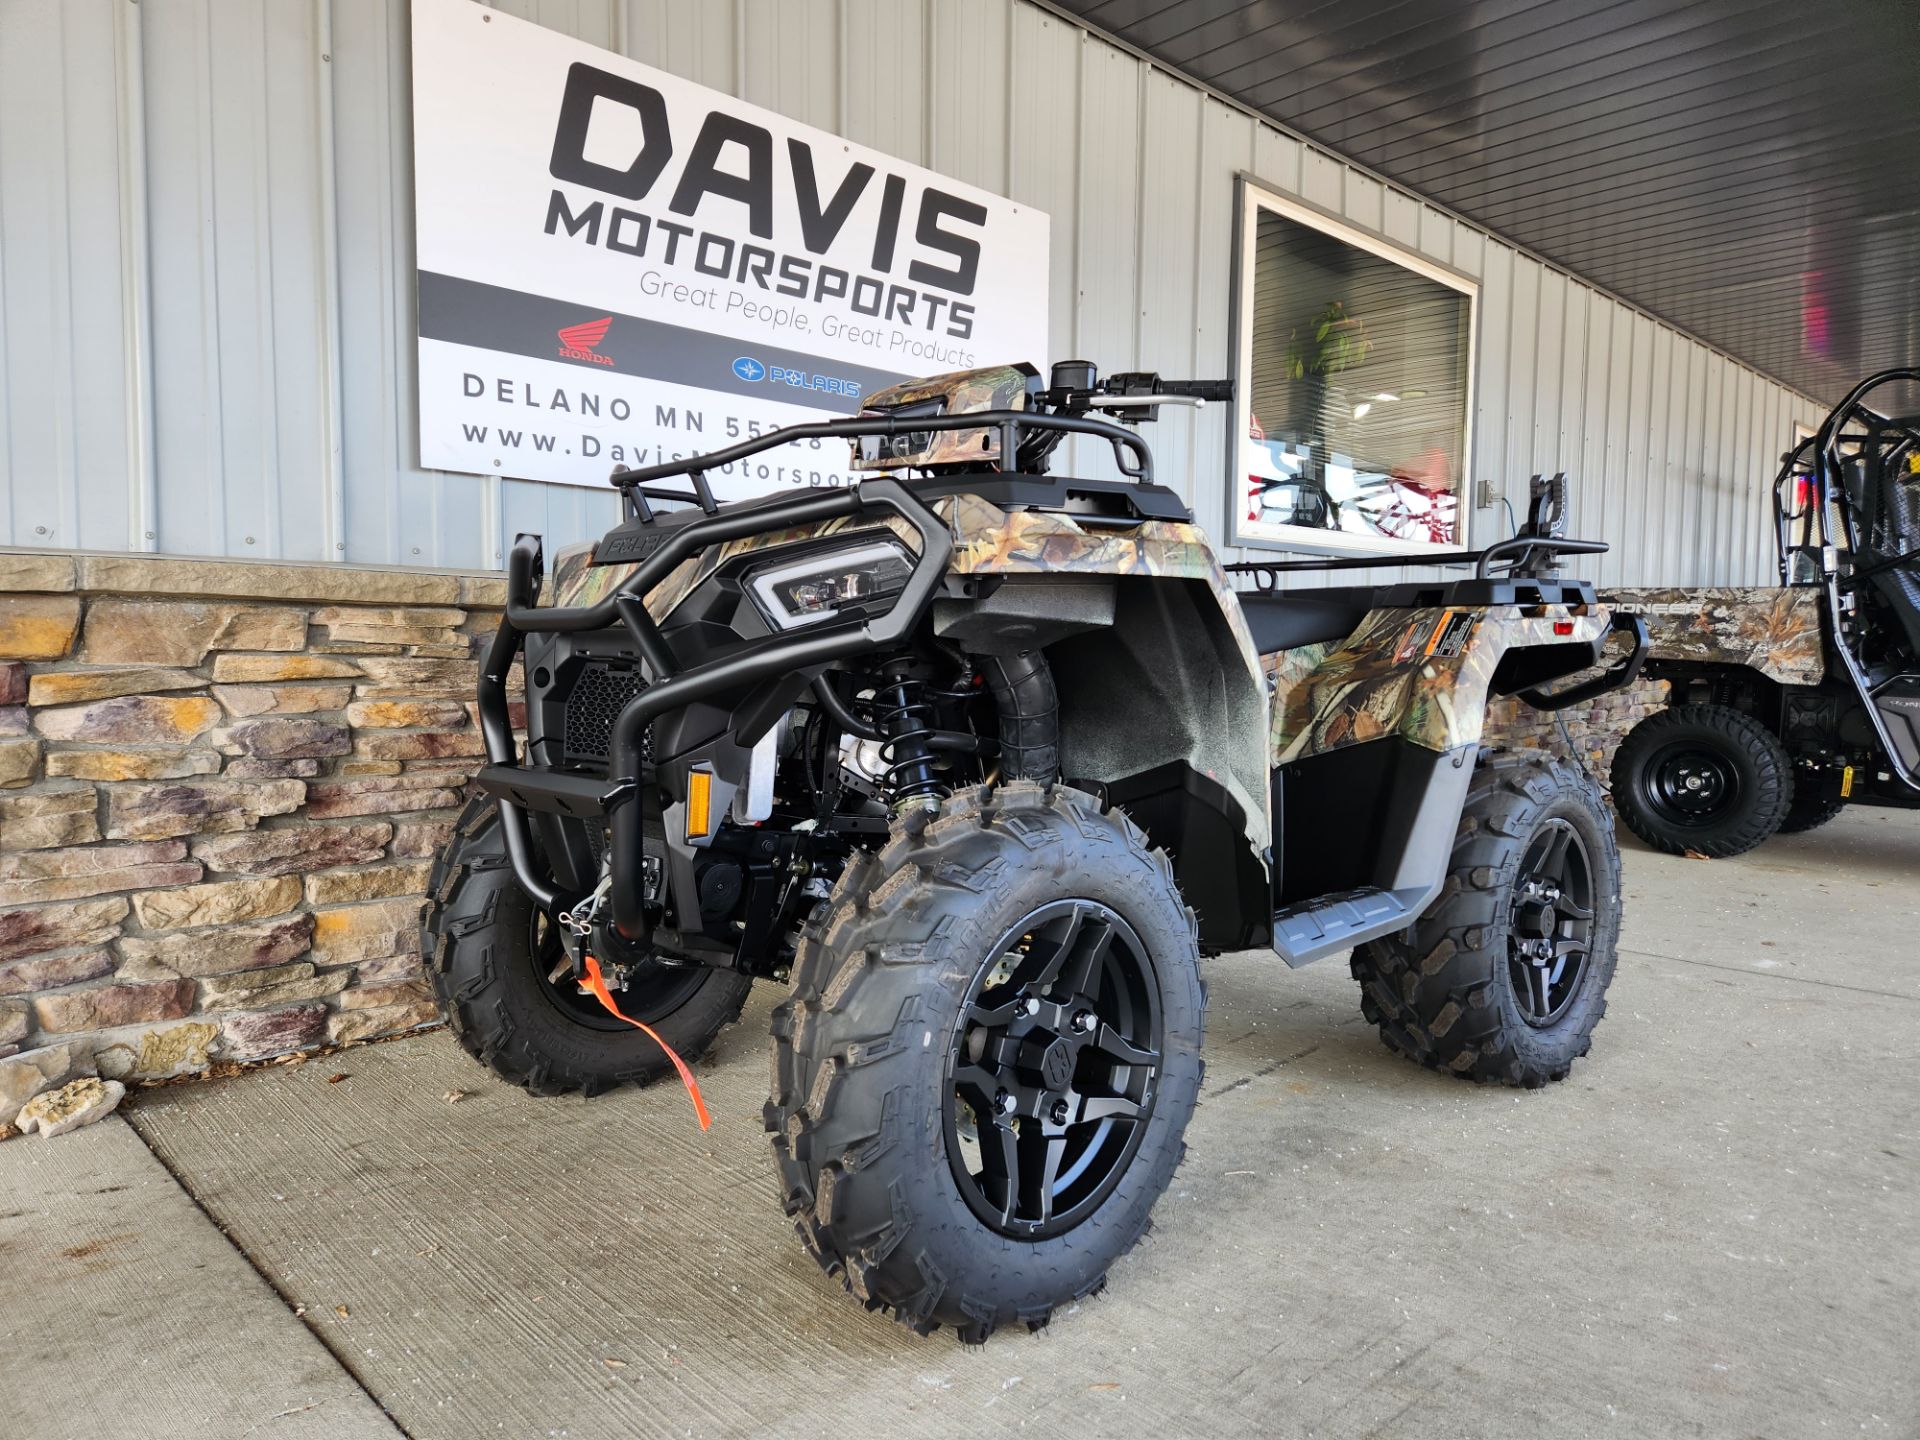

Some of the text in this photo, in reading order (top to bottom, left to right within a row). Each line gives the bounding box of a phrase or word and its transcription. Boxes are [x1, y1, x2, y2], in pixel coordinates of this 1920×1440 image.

[549, 61, 988, 297] DAVIS
[543, 188, 976, 340] MOTORSPORTS
[640, 270, 975, 368] Great People, Great Products
[558, 347, 615, 366] HONDA
[769, 365, 862, 398] POLARIS
[463, 372, 631, 421] DELANO
[655, 404, 703, 433] MN
[1605, 602, 1703, 614] PIONEER
